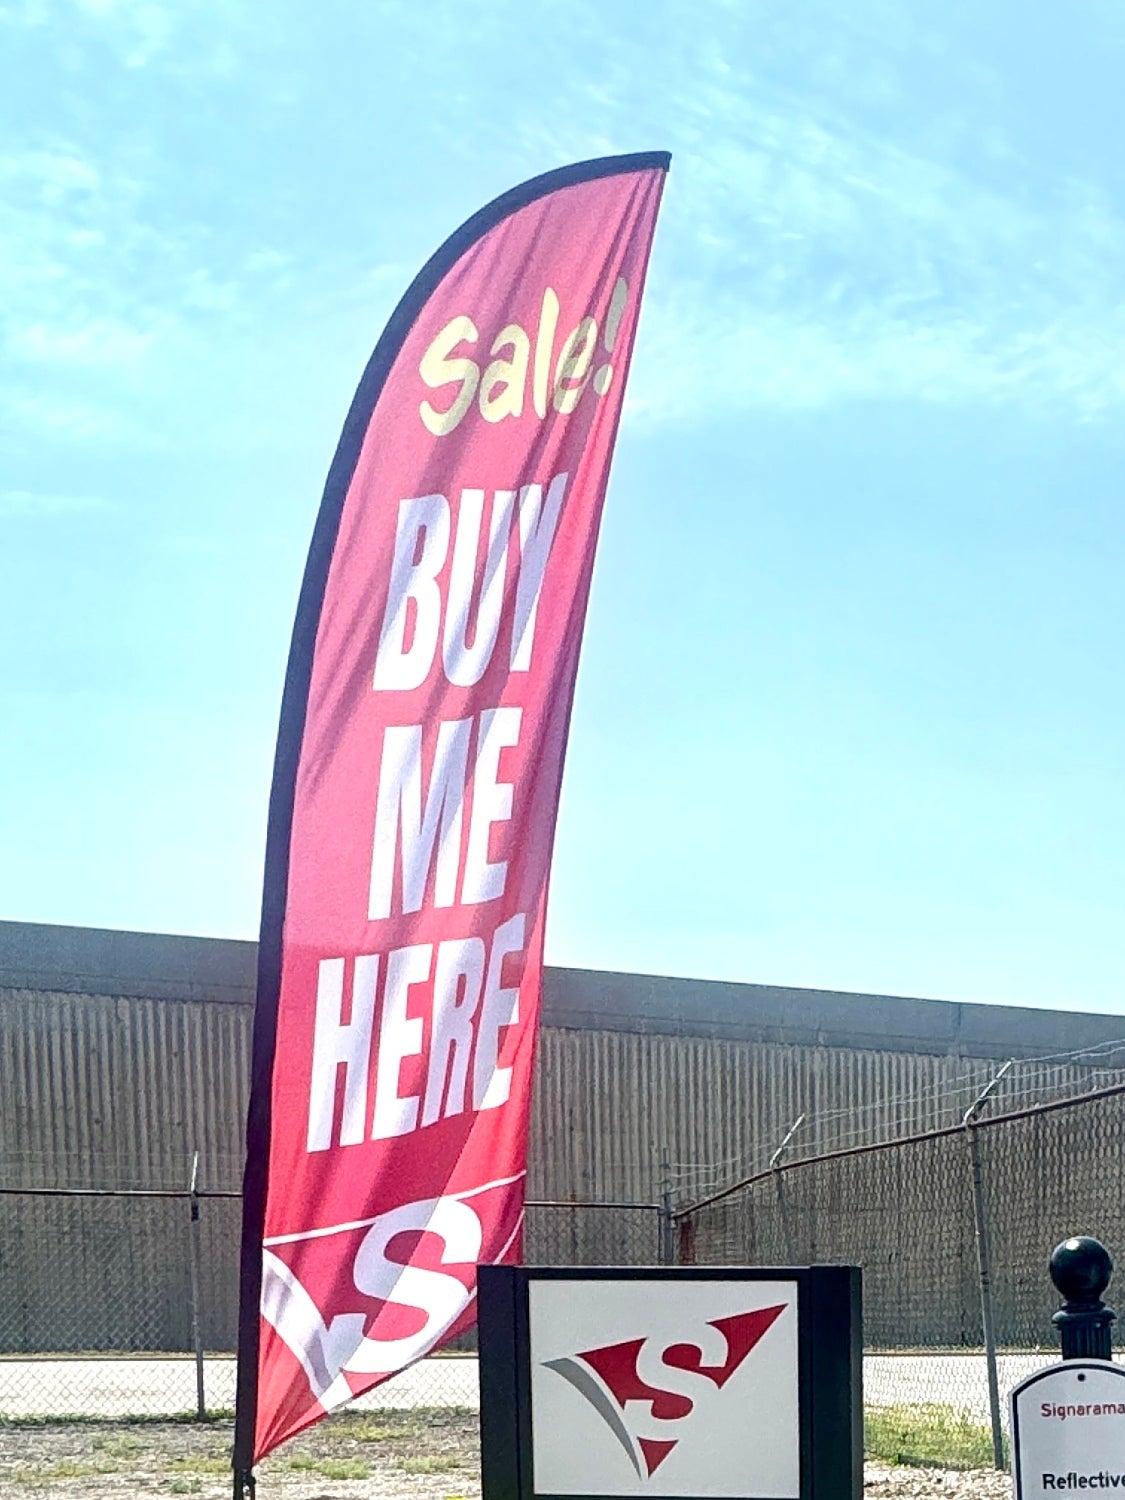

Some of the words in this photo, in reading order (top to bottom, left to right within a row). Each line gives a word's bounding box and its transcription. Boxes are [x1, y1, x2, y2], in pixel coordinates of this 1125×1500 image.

[418, 277, 628, 436] sale!
[373, 472, 568, 692] BUY
[367, 707, 523, 921] ME
[307, 913, 526, 1153] HERE
